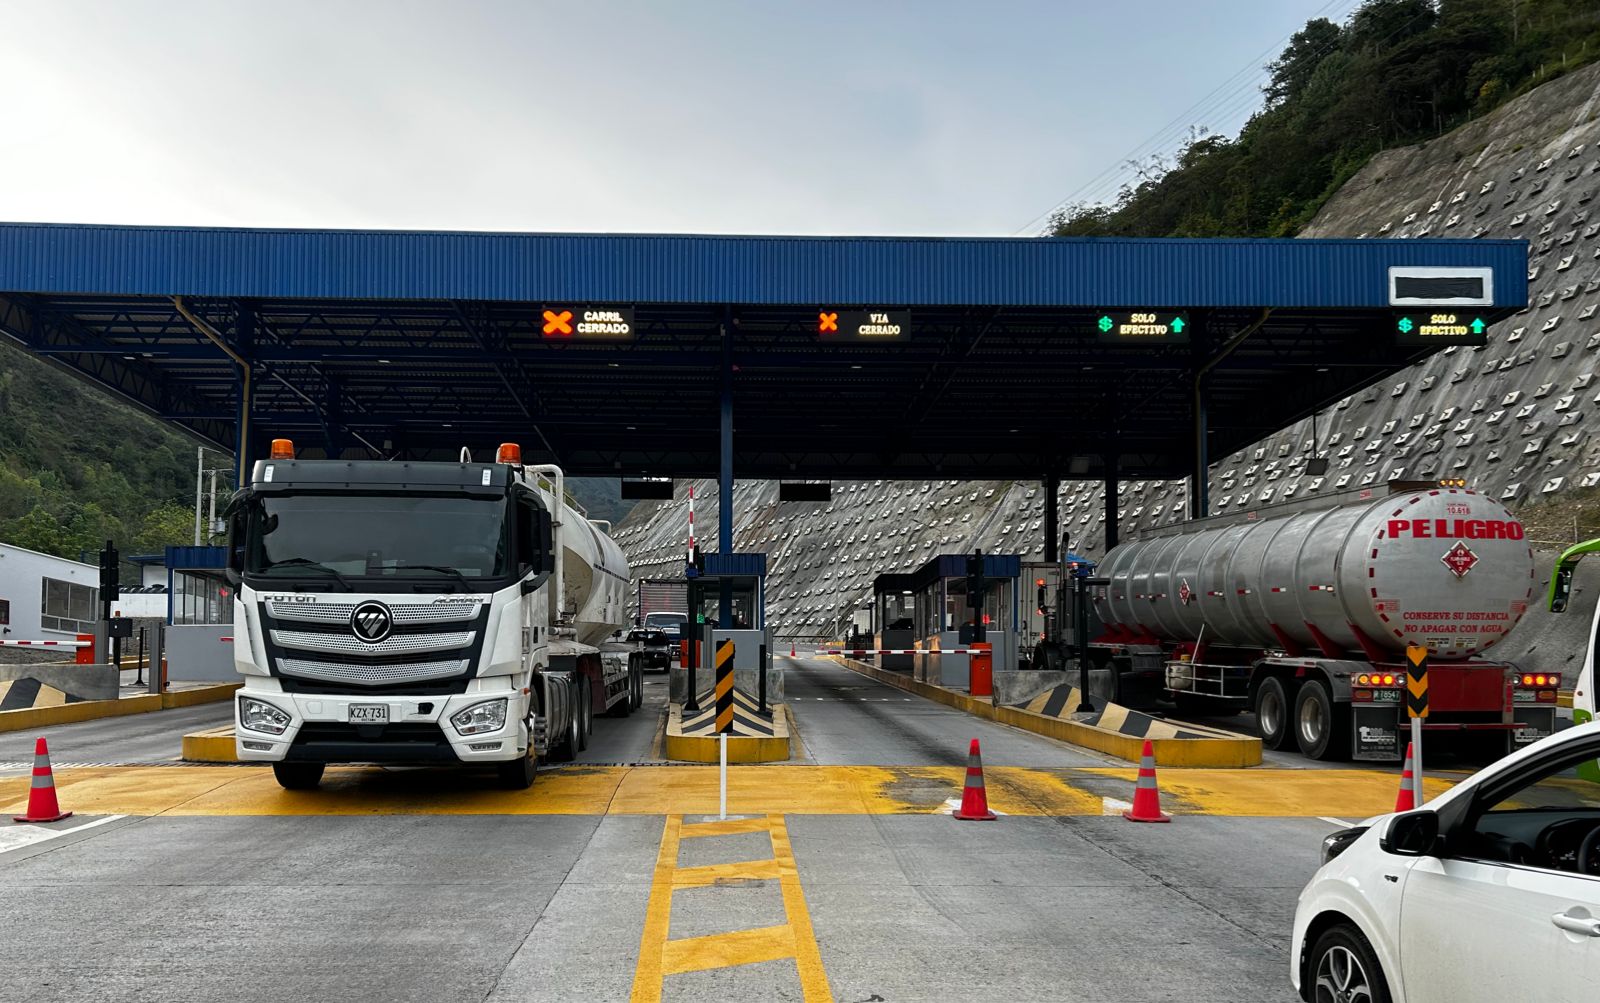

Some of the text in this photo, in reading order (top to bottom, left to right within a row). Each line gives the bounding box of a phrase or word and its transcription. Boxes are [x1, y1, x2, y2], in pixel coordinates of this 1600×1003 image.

[584, 311, 623, 322] CARRIL
[870, 313, 889, 323] VIA
[1131, 313, 1156, 323] SOLO
[1431, 314, 1456, 324] SOLO
[577, 323, 629, 333] CERRADO
[859, 325, 900, 335] CERRADO
[1120, 325, 1167, 335] EFECTIVO
[1420, 326, 1467, 336] EFECTIVO
[1387, 519, 1524, 540] PELIGRO
[264, 593, 317, 603] FOTON
[1403, 612, 1509, 621] CONSERVE SU DISTANCIA
[1404, 625, 1502, 633] NO APAGAR CON AGUA
